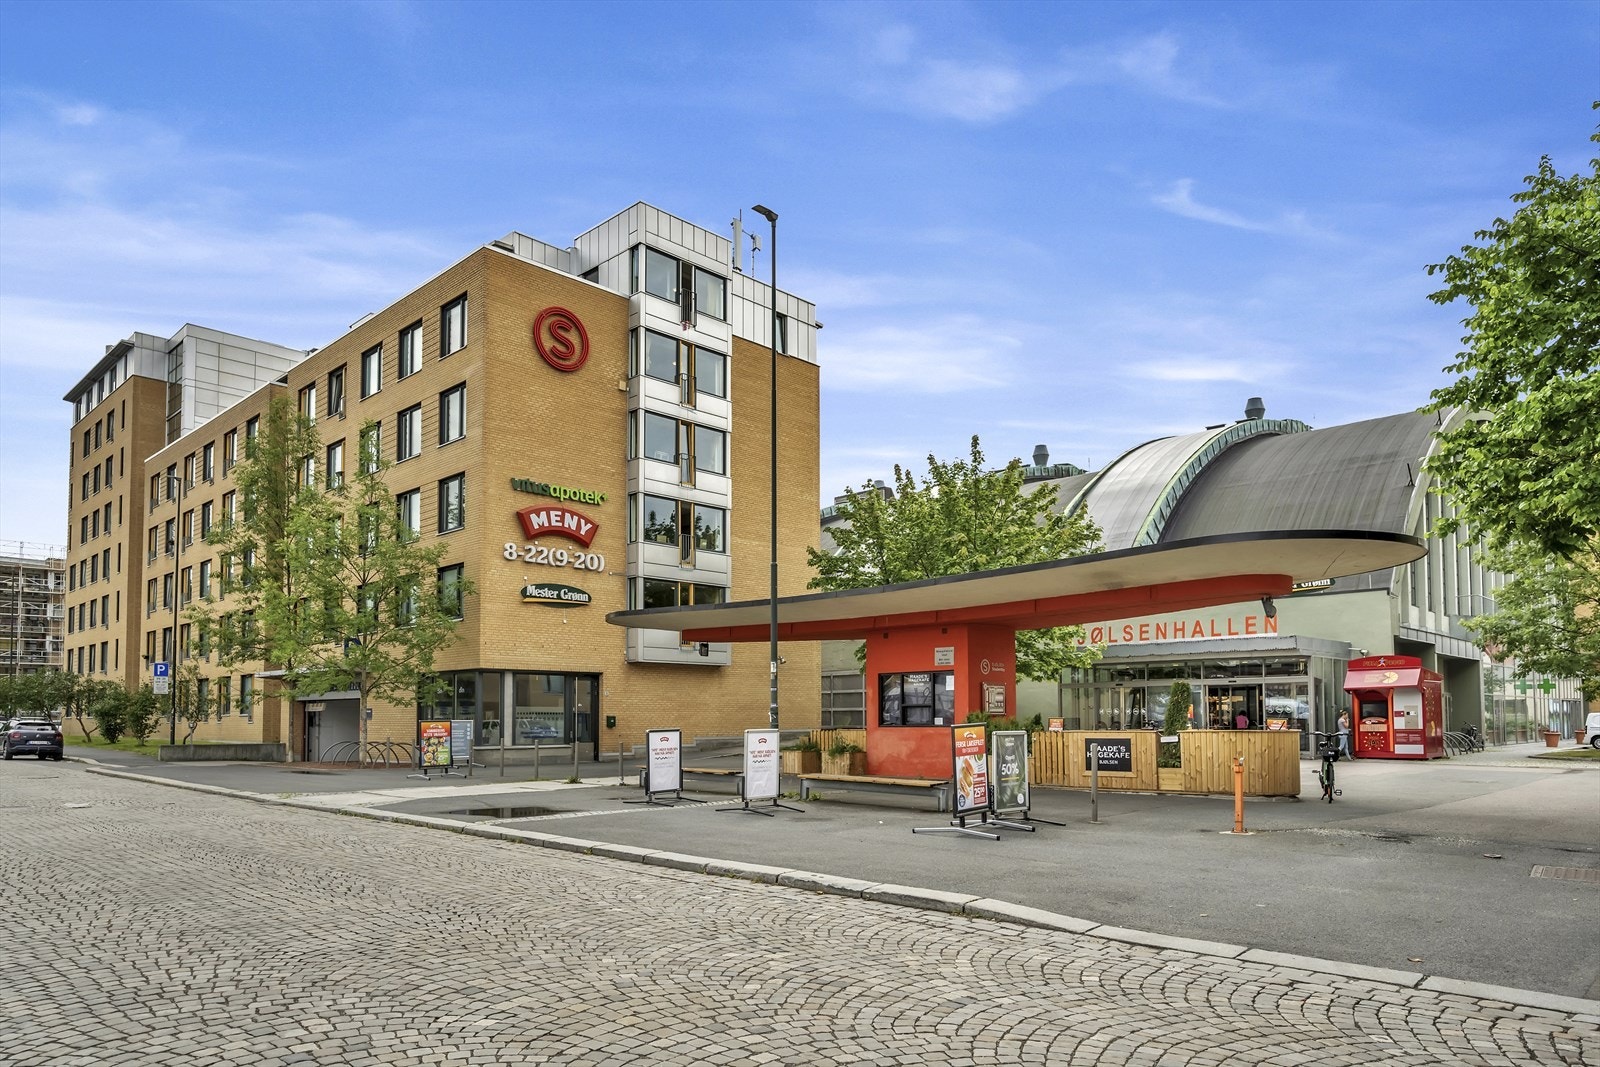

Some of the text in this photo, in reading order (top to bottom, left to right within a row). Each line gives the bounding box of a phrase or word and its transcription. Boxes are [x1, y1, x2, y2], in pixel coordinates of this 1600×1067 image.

[529, 510, 593, 536] MENY
[503, 542, 605, 572] 8-22(9-20)
[526, 584, 589, 602] Mester Grønn
[157, 664, 166, 676] P
[1087, 751, 1130, 759] HGEKAFE
[1001, 763, 1020, 775] 50%
